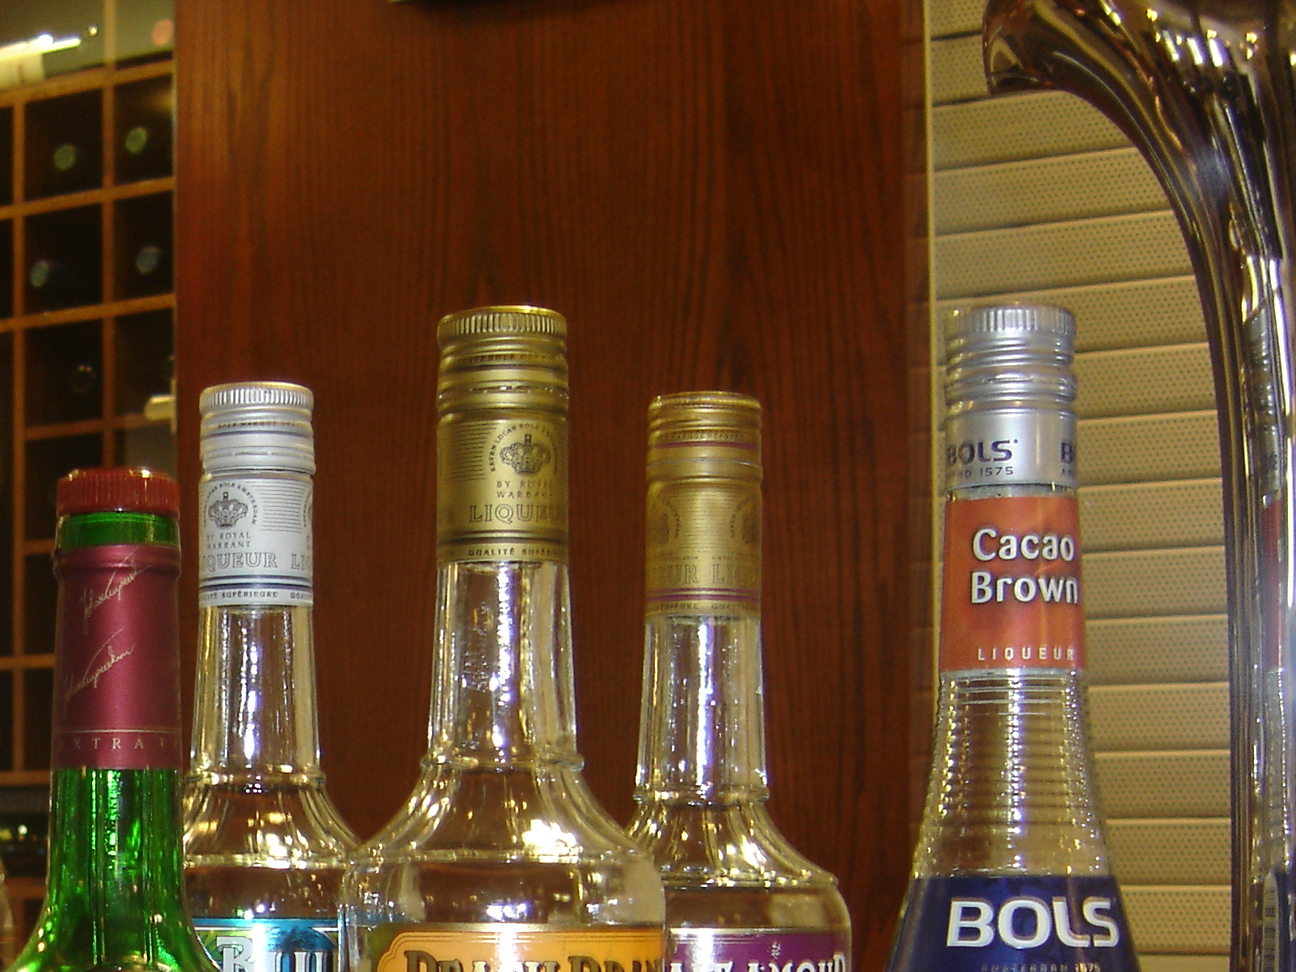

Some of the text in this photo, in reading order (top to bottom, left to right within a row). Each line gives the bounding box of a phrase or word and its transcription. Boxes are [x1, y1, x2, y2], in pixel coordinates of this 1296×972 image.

[980, 466, 1014, 476] 1575
[973, 528, 1075, 562] Cacao
[971, 571, 1078, 605] Brown
[978, 647, 1076, 661] LIQUEUR
[946, 896, 1120, 949] BOLS
